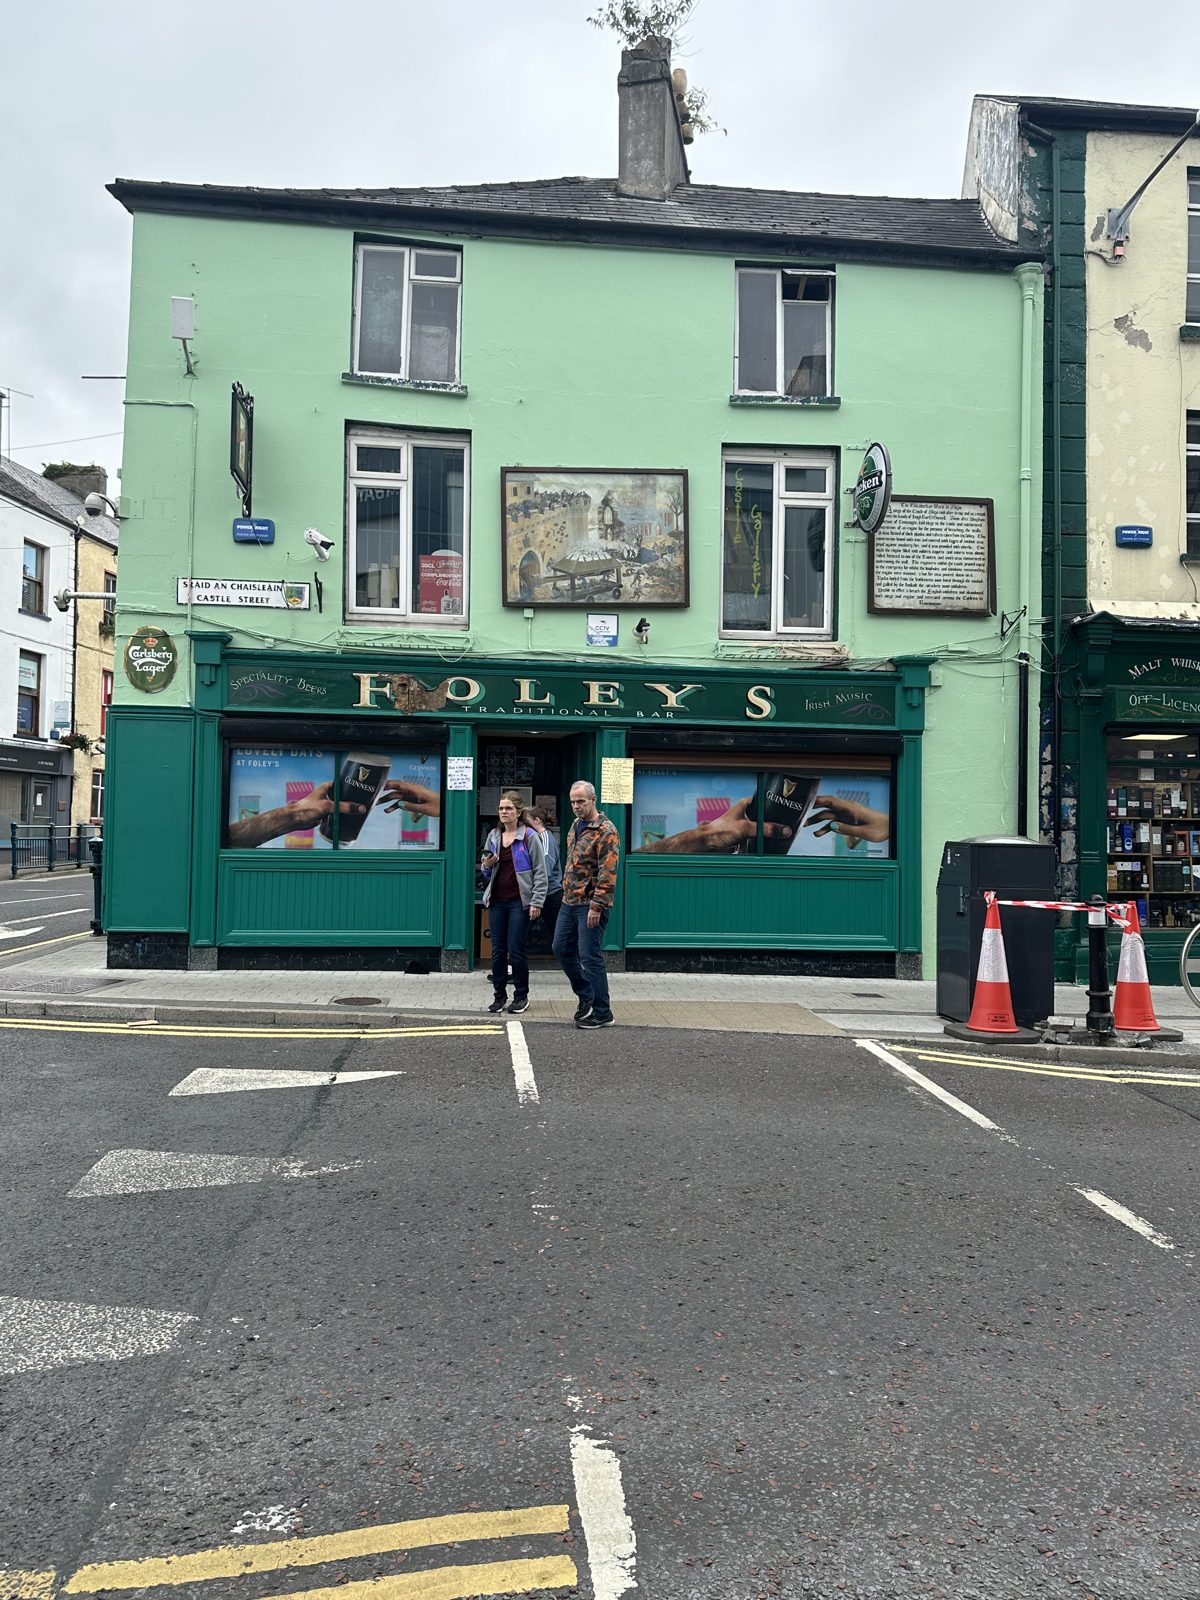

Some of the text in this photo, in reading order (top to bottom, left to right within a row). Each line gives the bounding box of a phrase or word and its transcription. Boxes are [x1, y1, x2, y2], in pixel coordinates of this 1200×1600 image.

[214, 582, 227, 590] AN
[197, 594, 270, 604] CASTLE STREET
[129, 646, 173, 663] Carlsberg
[136, 662, 168, 677] Lager
[1128, 658, 1163, 680] MALT
[462, 705, 675, 719] TRADITIONAL BAR
[248, 760, 280, 768] FOLEY'S
[344, 776, 376, 793] GUINNESS
[766, 790, 803, 811] GUINNESS
